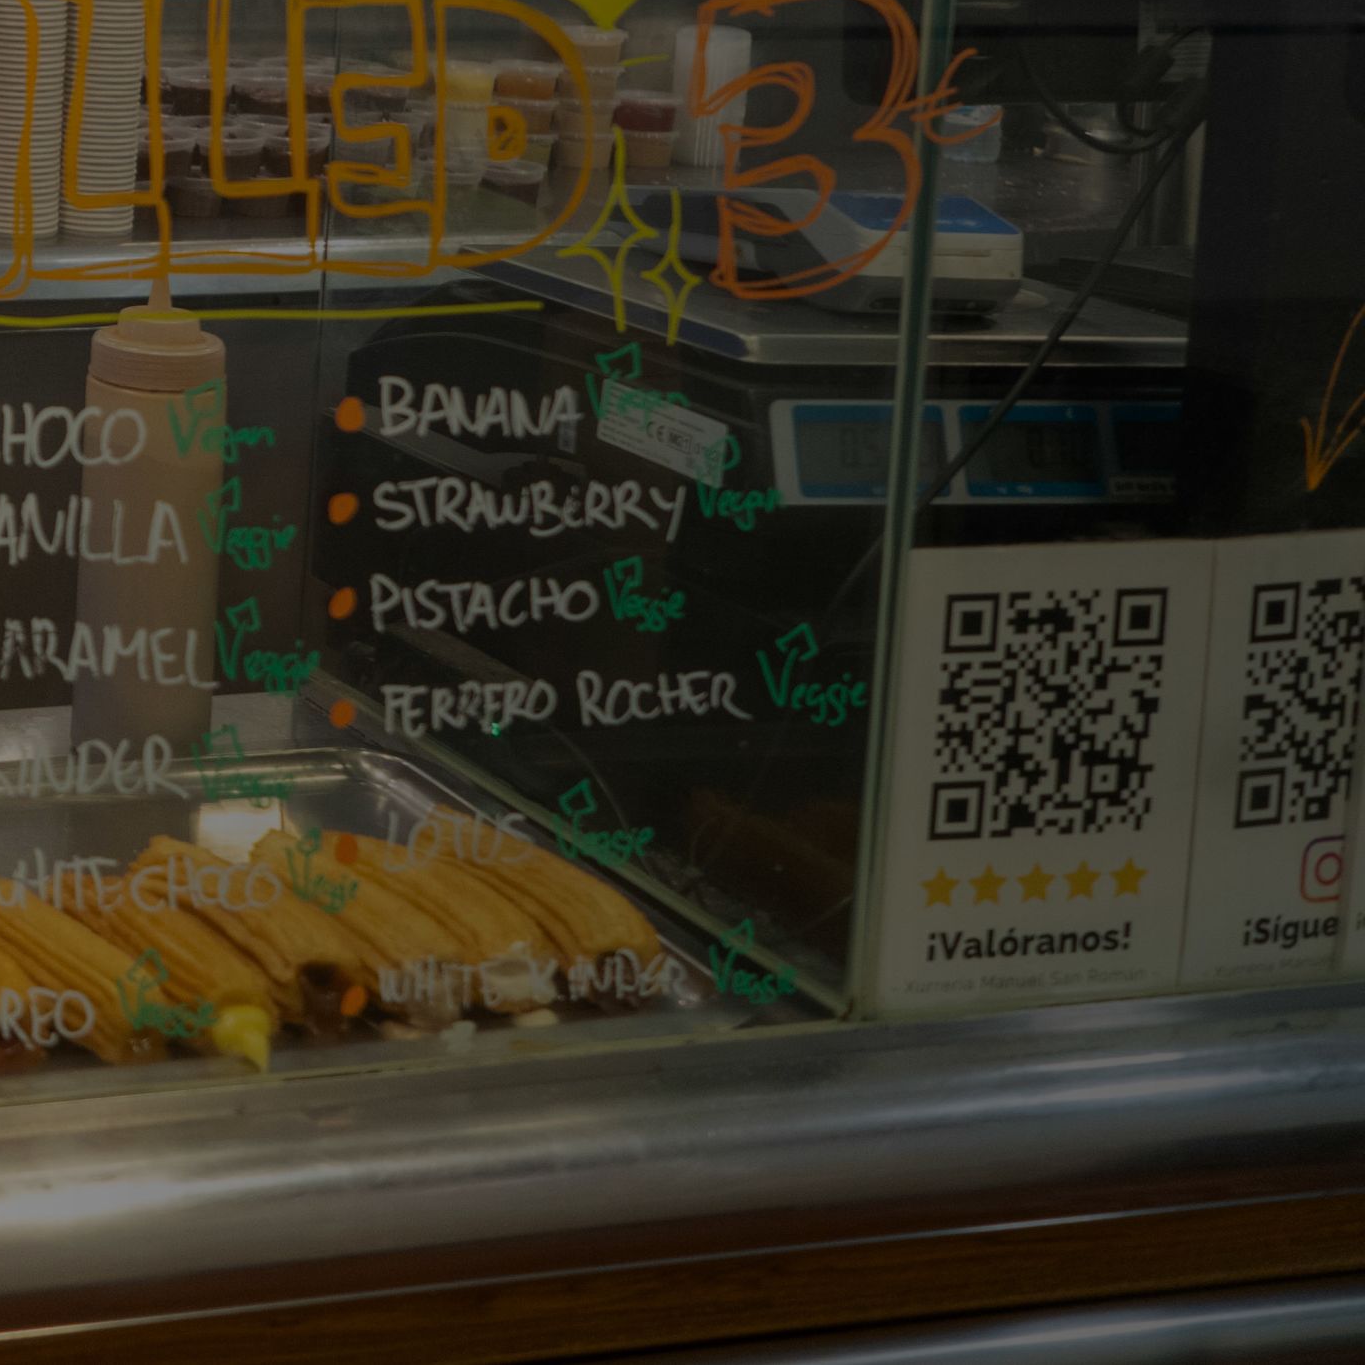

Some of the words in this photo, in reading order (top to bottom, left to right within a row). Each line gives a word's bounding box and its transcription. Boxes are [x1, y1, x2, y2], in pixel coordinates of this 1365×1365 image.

[170, 394, 276, 463] Vegan
[377, 374, 583, 437] BANANA
[693, 476, 783, 532] Vegan
[370, 574, 599, 633] PISTACHO
[604, 564, 687, 632] Veggie
[381, 677, 558, 737] FERRERO
[576, 669, 753, 727] ROCHER
[757, 647, 869, 726] Veggie
[383, 808, 531, 872] LOTUS
[129, 855, 283, 912] CHOCO
[925, 921, 1133, 962] ¡Valóranos!
[377, 953, 502, 1008] WHITE
